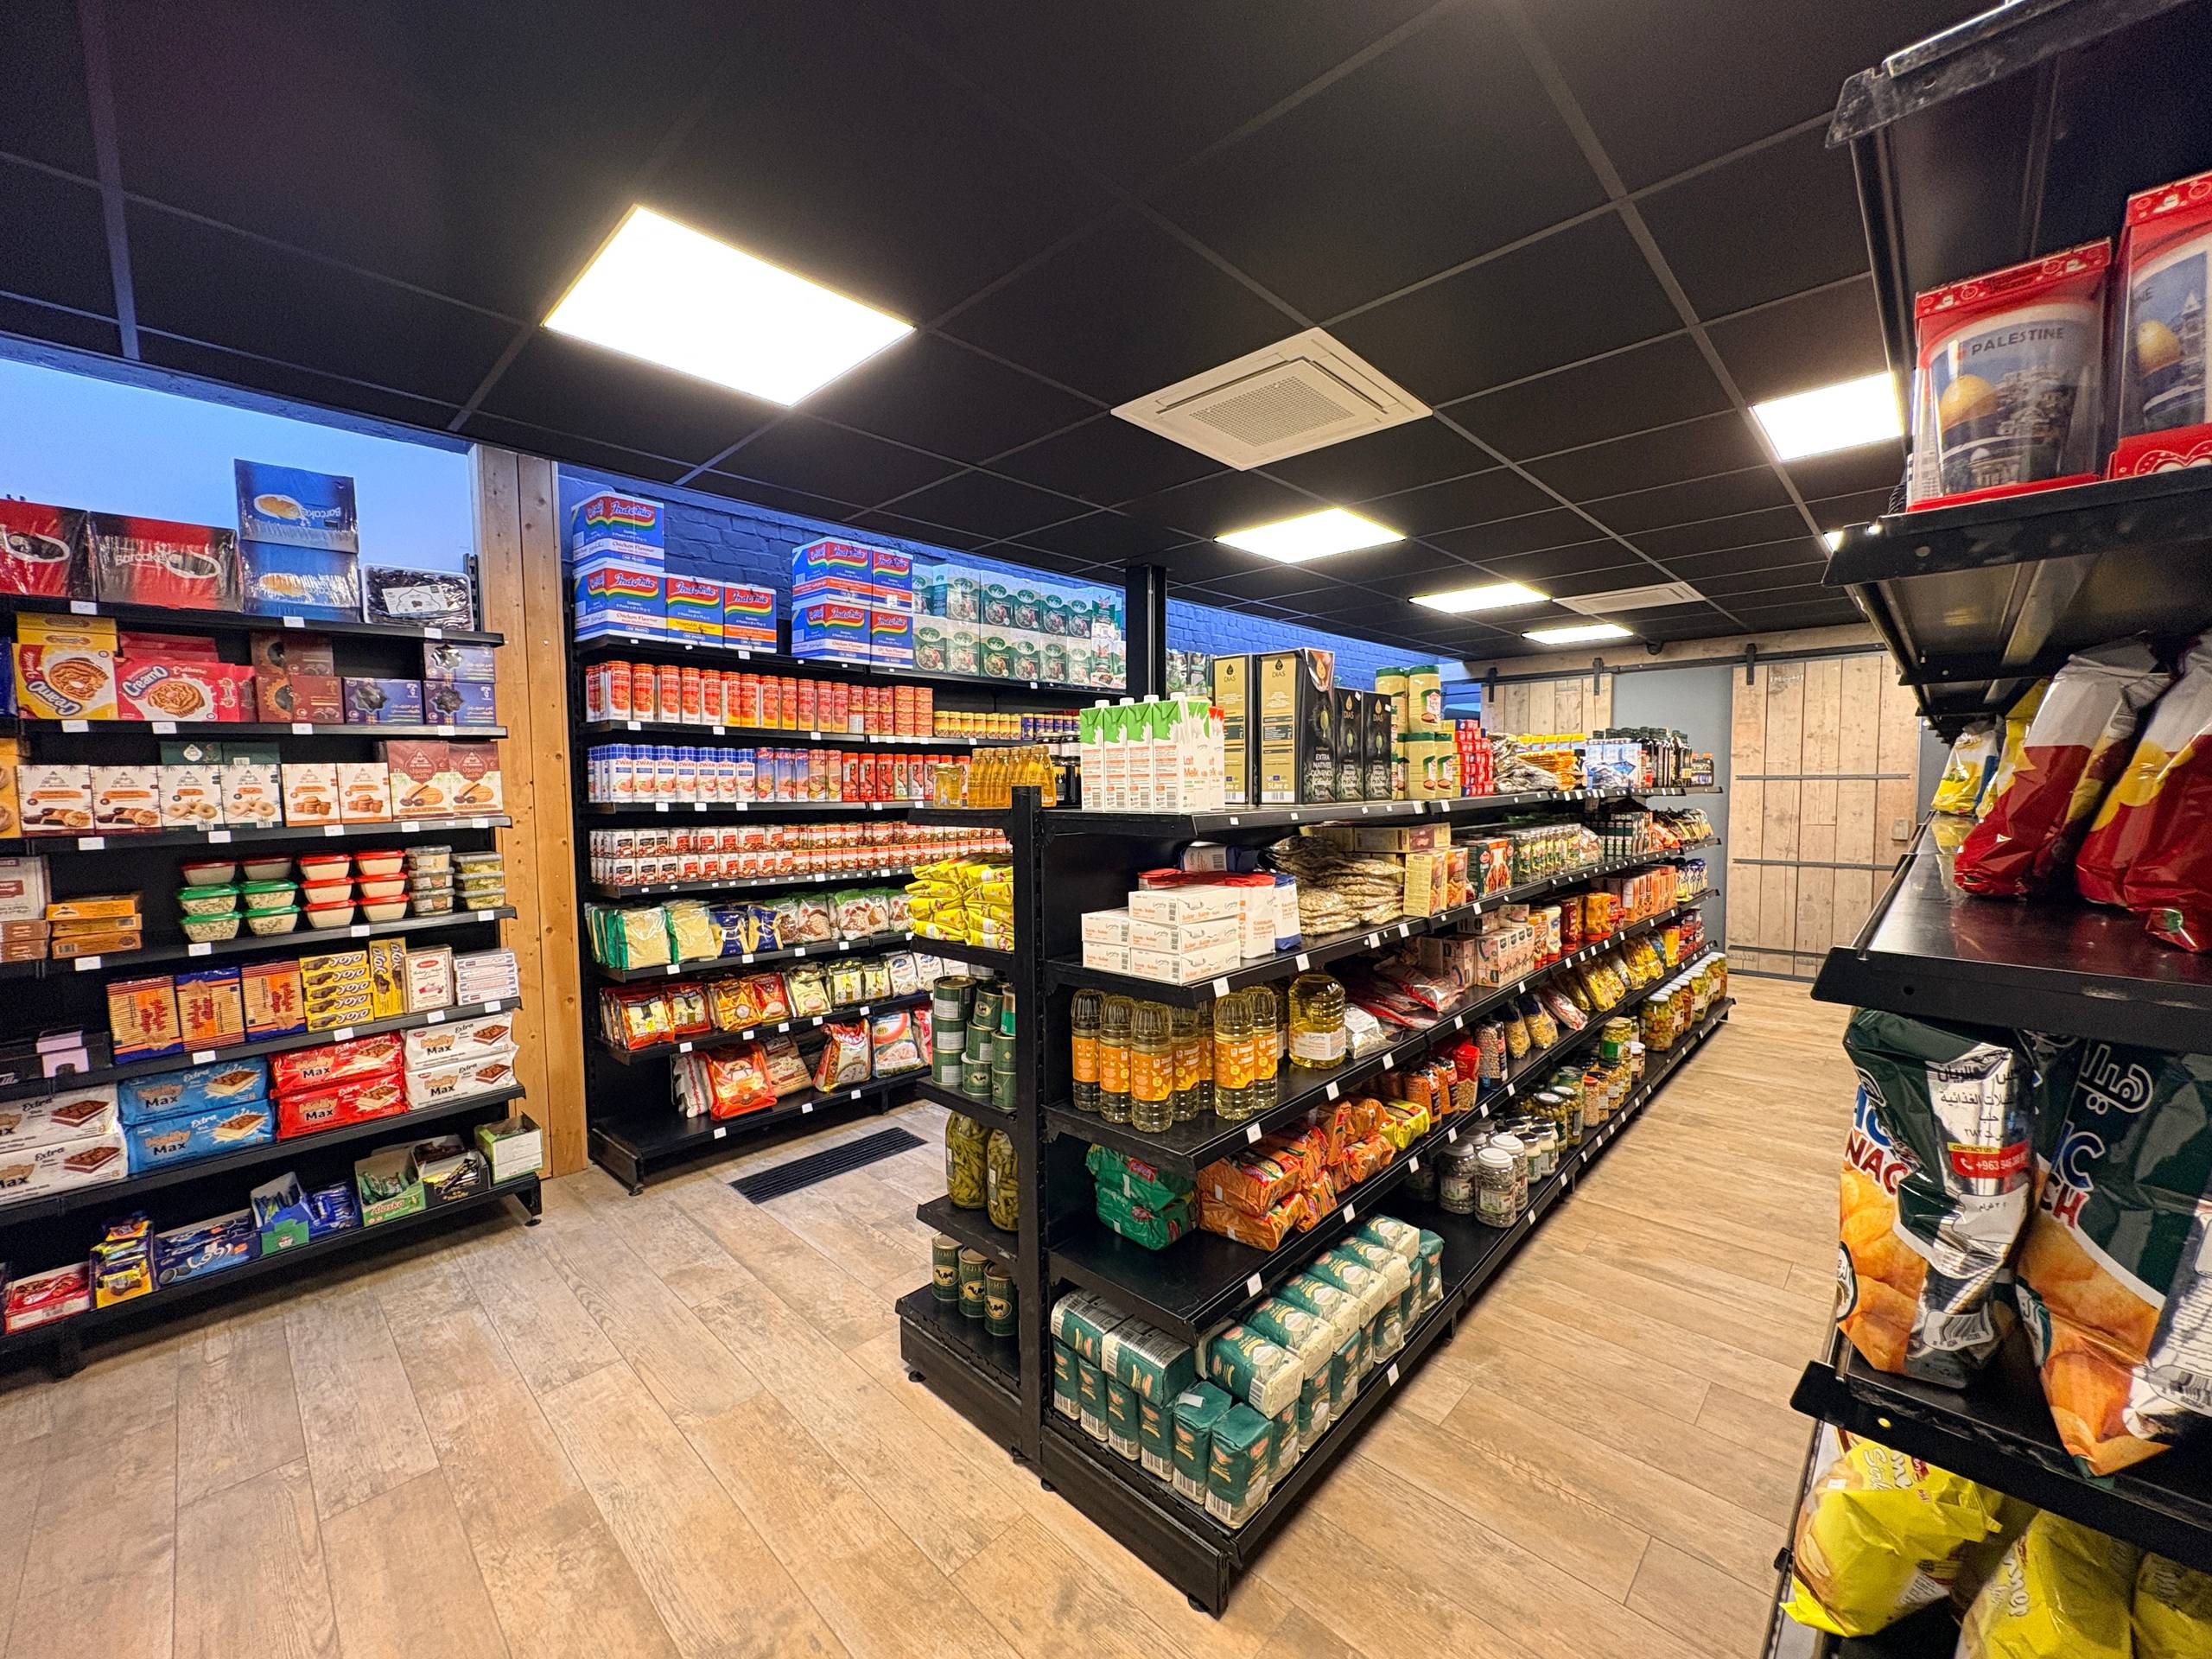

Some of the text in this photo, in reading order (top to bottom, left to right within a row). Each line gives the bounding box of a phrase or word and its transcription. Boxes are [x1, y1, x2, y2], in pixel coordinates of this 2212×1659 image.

[1972, 327, 2065, 355] PALESTINE
[454, 1023, 474, 1033] Extra
[427, 1045, 452, 1055] Max
[303, 1066, 330, 1078] Max
[459, 1063, 478, 1074] Extra
[430, 1086, 455, 1096] Max
[145, 1095, 178, 1109] Max
[191, 1114, 218, 1128] Extra
[305, 1109, 334, 1121] Max
[35, 1147, 65, 1162] Extra
[153, 1142, 187, 1156] Max
[1976, 1160, 1999, 1171] +963
[371, 1199, 404, 1216] Alaska
